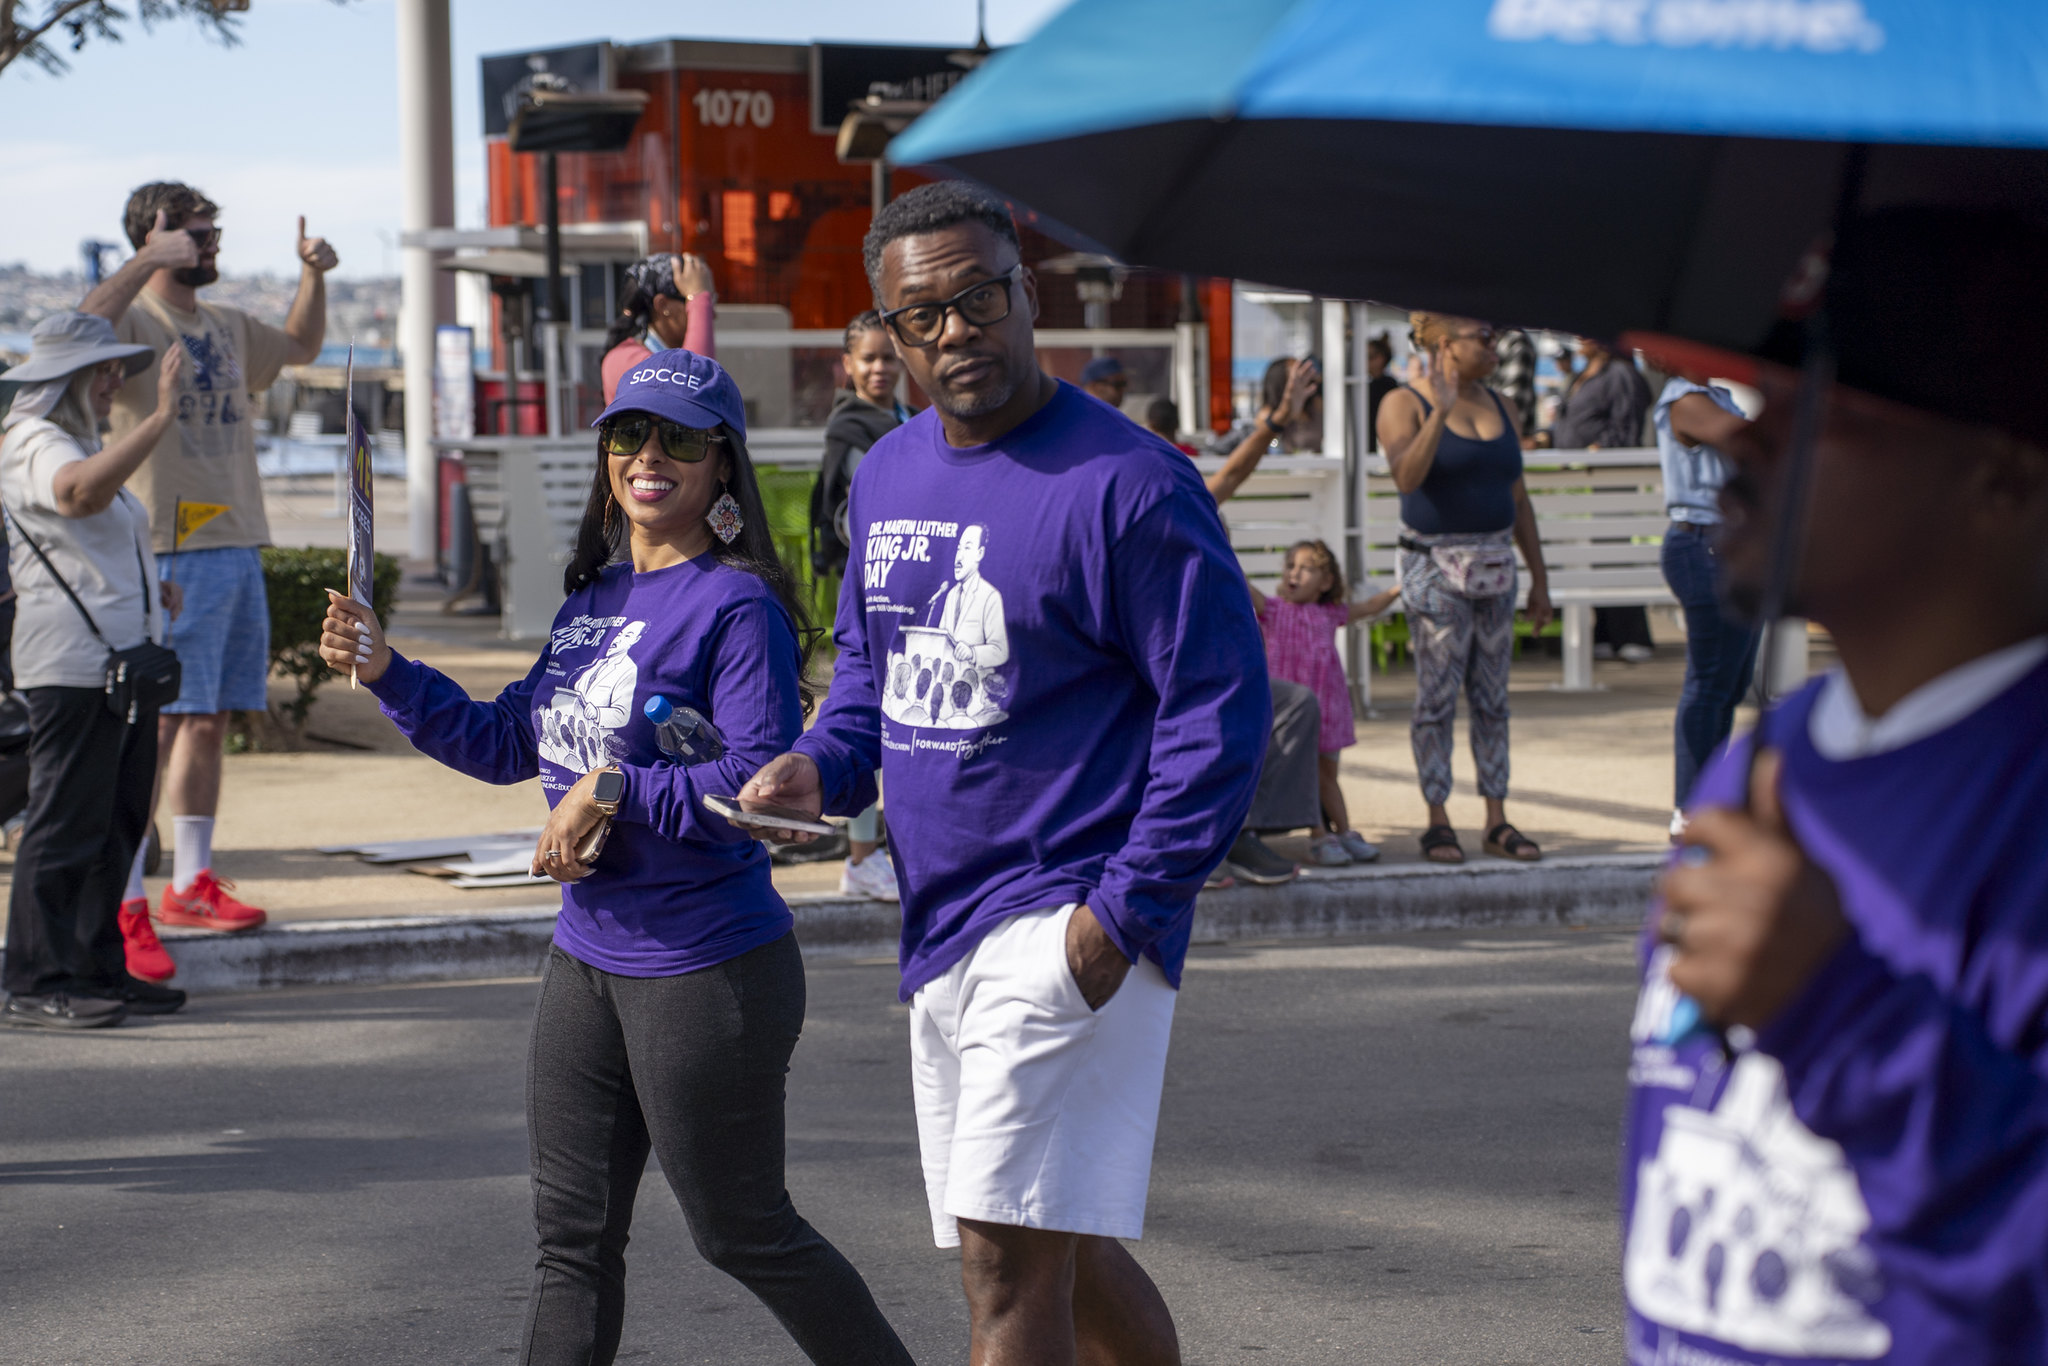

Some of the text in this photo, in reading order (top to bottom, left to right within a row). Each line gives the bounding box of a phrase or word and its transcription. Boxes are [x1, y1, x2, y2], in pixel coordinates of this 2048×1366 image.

[694, 89, 774, 128] 1070
[630, 368, 701, 391] SDCCE
[882, 519, 917, 535] MARTIN
[915, 520, 959, 538] LUTHER
[865, 535, 931, 562] KING JR.
